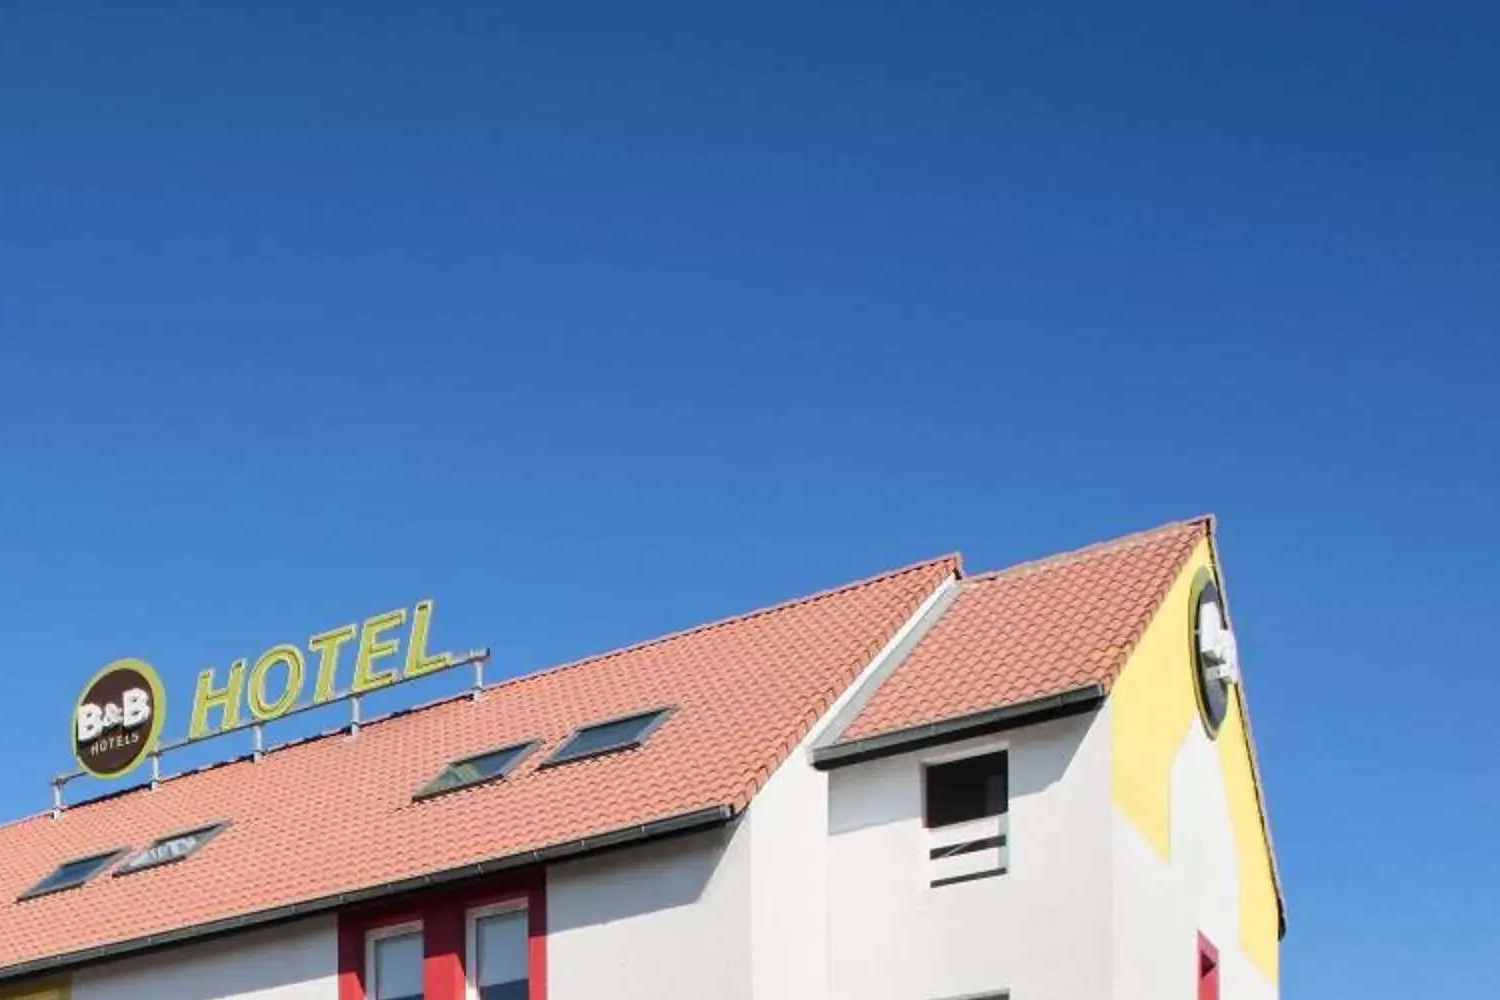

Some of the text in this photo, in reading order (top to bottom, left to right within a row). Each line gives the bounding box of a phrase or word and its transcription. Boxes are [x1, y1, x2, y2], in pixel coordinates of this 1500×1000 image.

[190, 599, 452, 738] HOTEL
[78, 688, 150, 741] B&B
[90, 733, 139, 756] HOTELS
